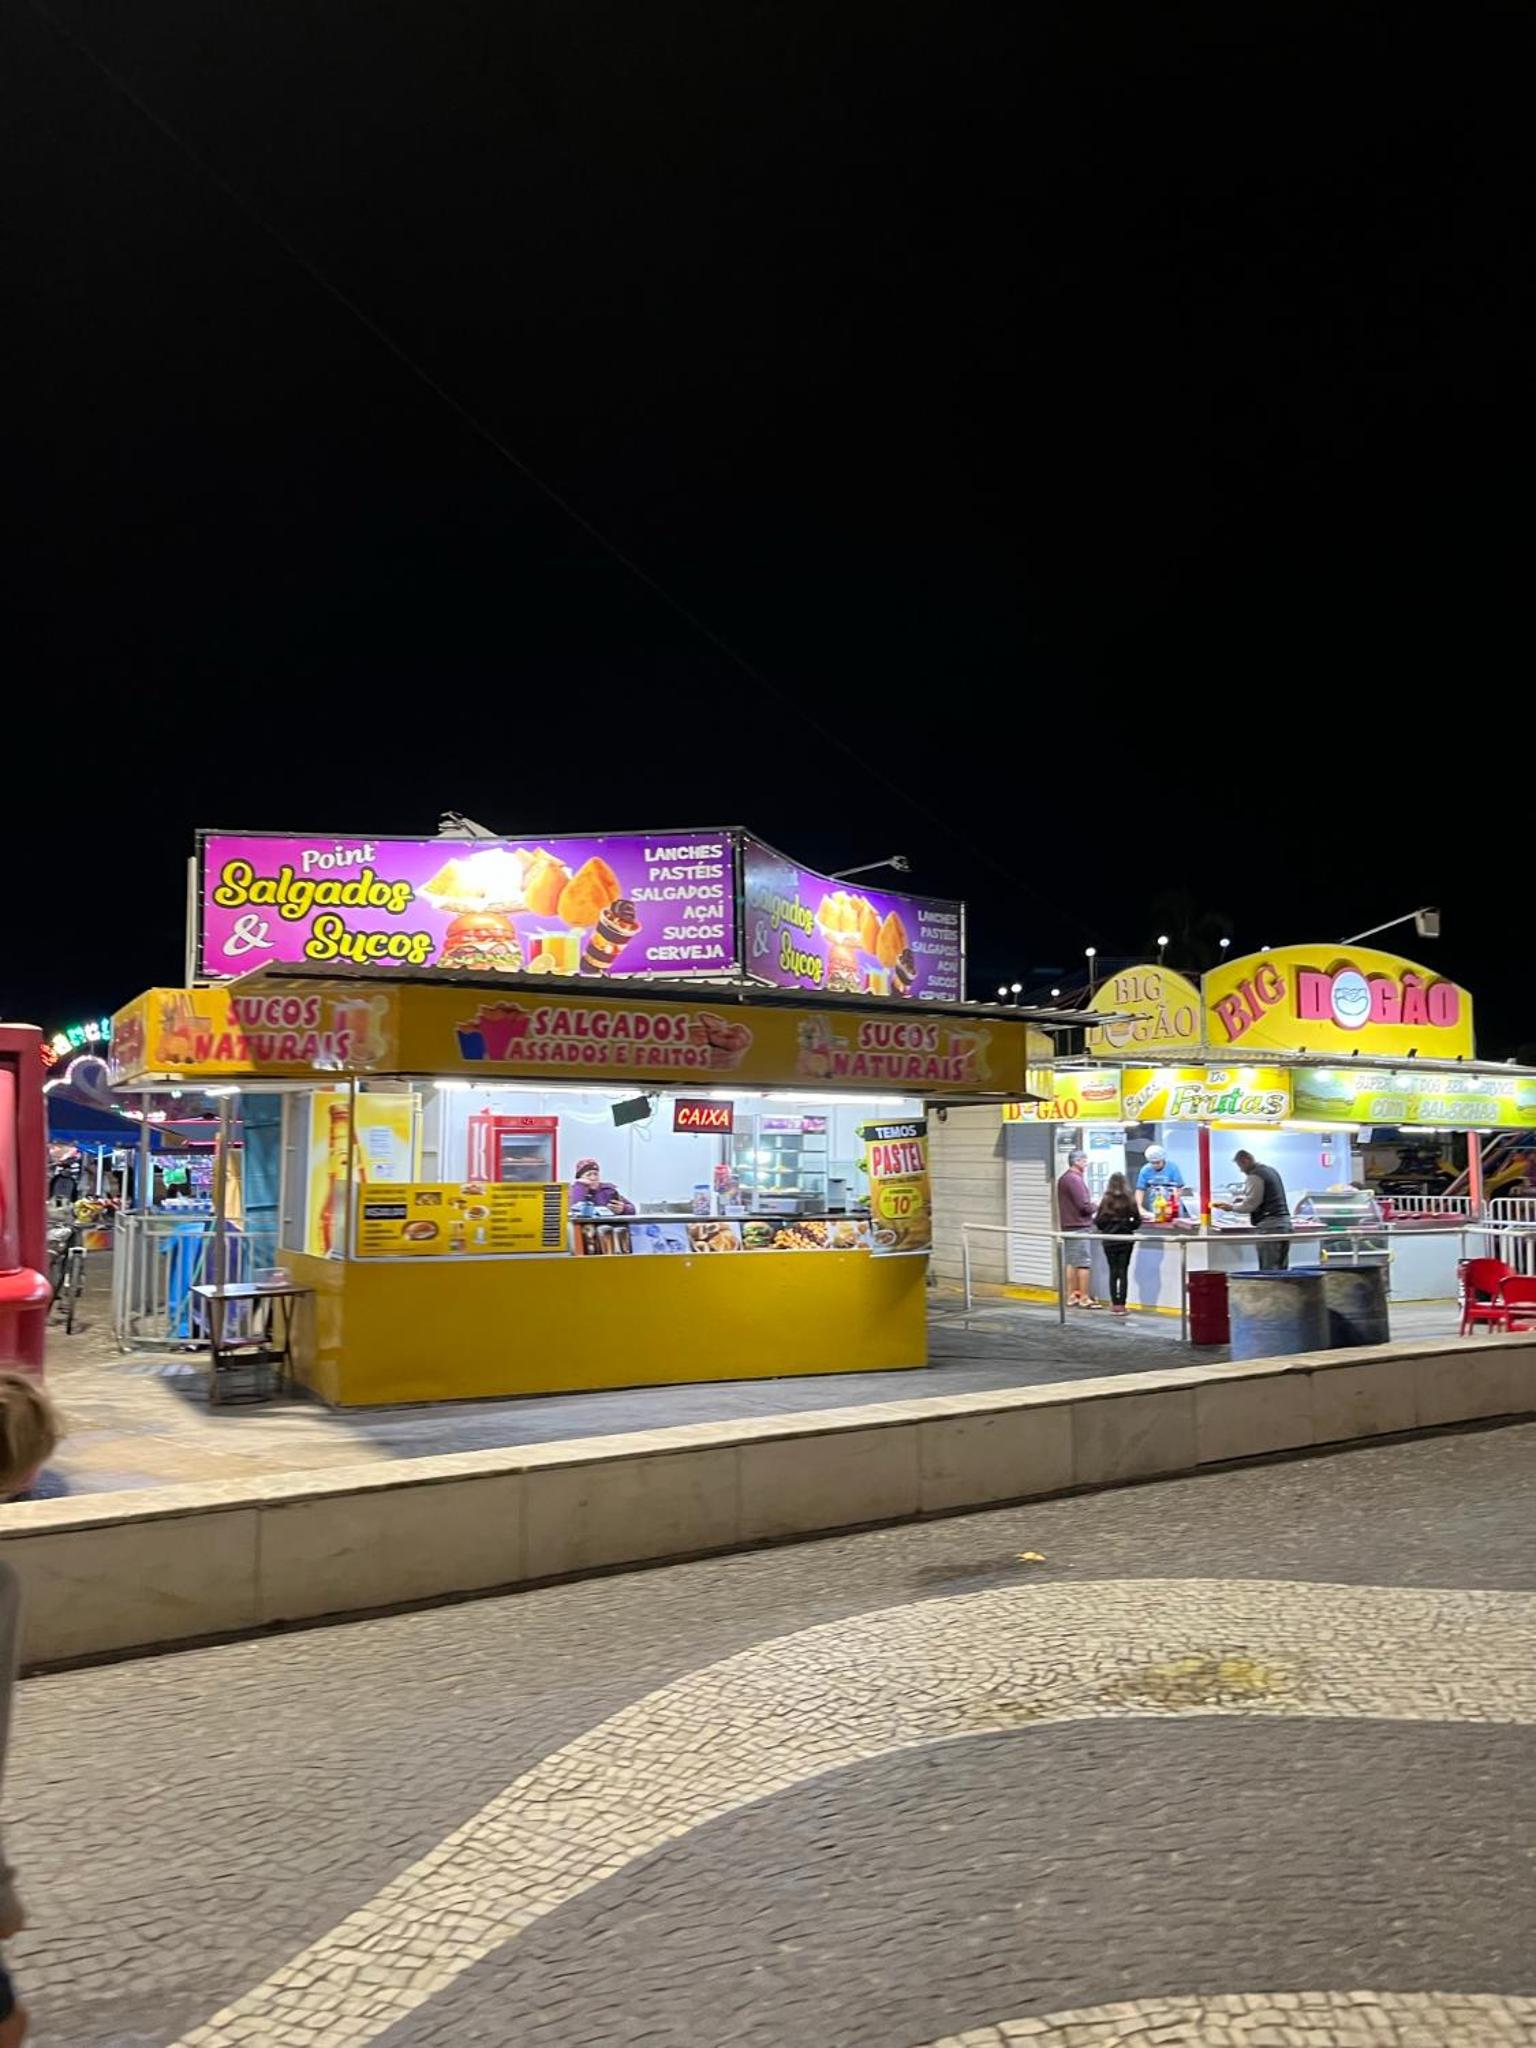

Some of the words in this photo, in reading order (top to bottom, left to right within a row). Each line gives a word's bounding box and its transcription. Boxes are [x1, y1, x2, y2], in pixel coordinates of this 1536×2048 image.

[301, 843, 375, 873] Point
[644, 844, 722, 862] LANCHES
[649, 861, 722, 881] PASTÉIS
[215, 860, 414, 921] Salgados
[631, 884, 723, 901] SALGADOS
[684, 901, 723, 921] AÇAÍ
[224, 914, 274, 957] &
[304, 912, 435, 965] Sucos
[663, 924, 723, 941] SUCOS
[646, 943, 724, 961] CERVEJA
[779, 929, 823, 984] Sucos
[1113, 971, 1164, 1005] BIG
[1211, 963, 1287, 1042] BIG
[1295, 962, 1460, 1030] DOGÃO
[229, 996, 321, 1028] SUCOS
[534, 1009, 689, 1041] SALGADOS
[195, 1031, 354, 1062] NATURAIS
[861, 1021, 939, 1051] SUCOS
[508, 1040, 608, 1062] ASSADOS
[615, 1043, 627, 1063] E
[635, 1045, 711, 1067] FRITOS
[831, 1051, 965, 1081] NATURAIS
[1170, 1083, 1288, 1117] Frutas
[677, 1108, 730, 1127] CAIXA
[875, 1125, 917, 1139] TEMOS
[873, 1143, 926, 1176] PASTEL
